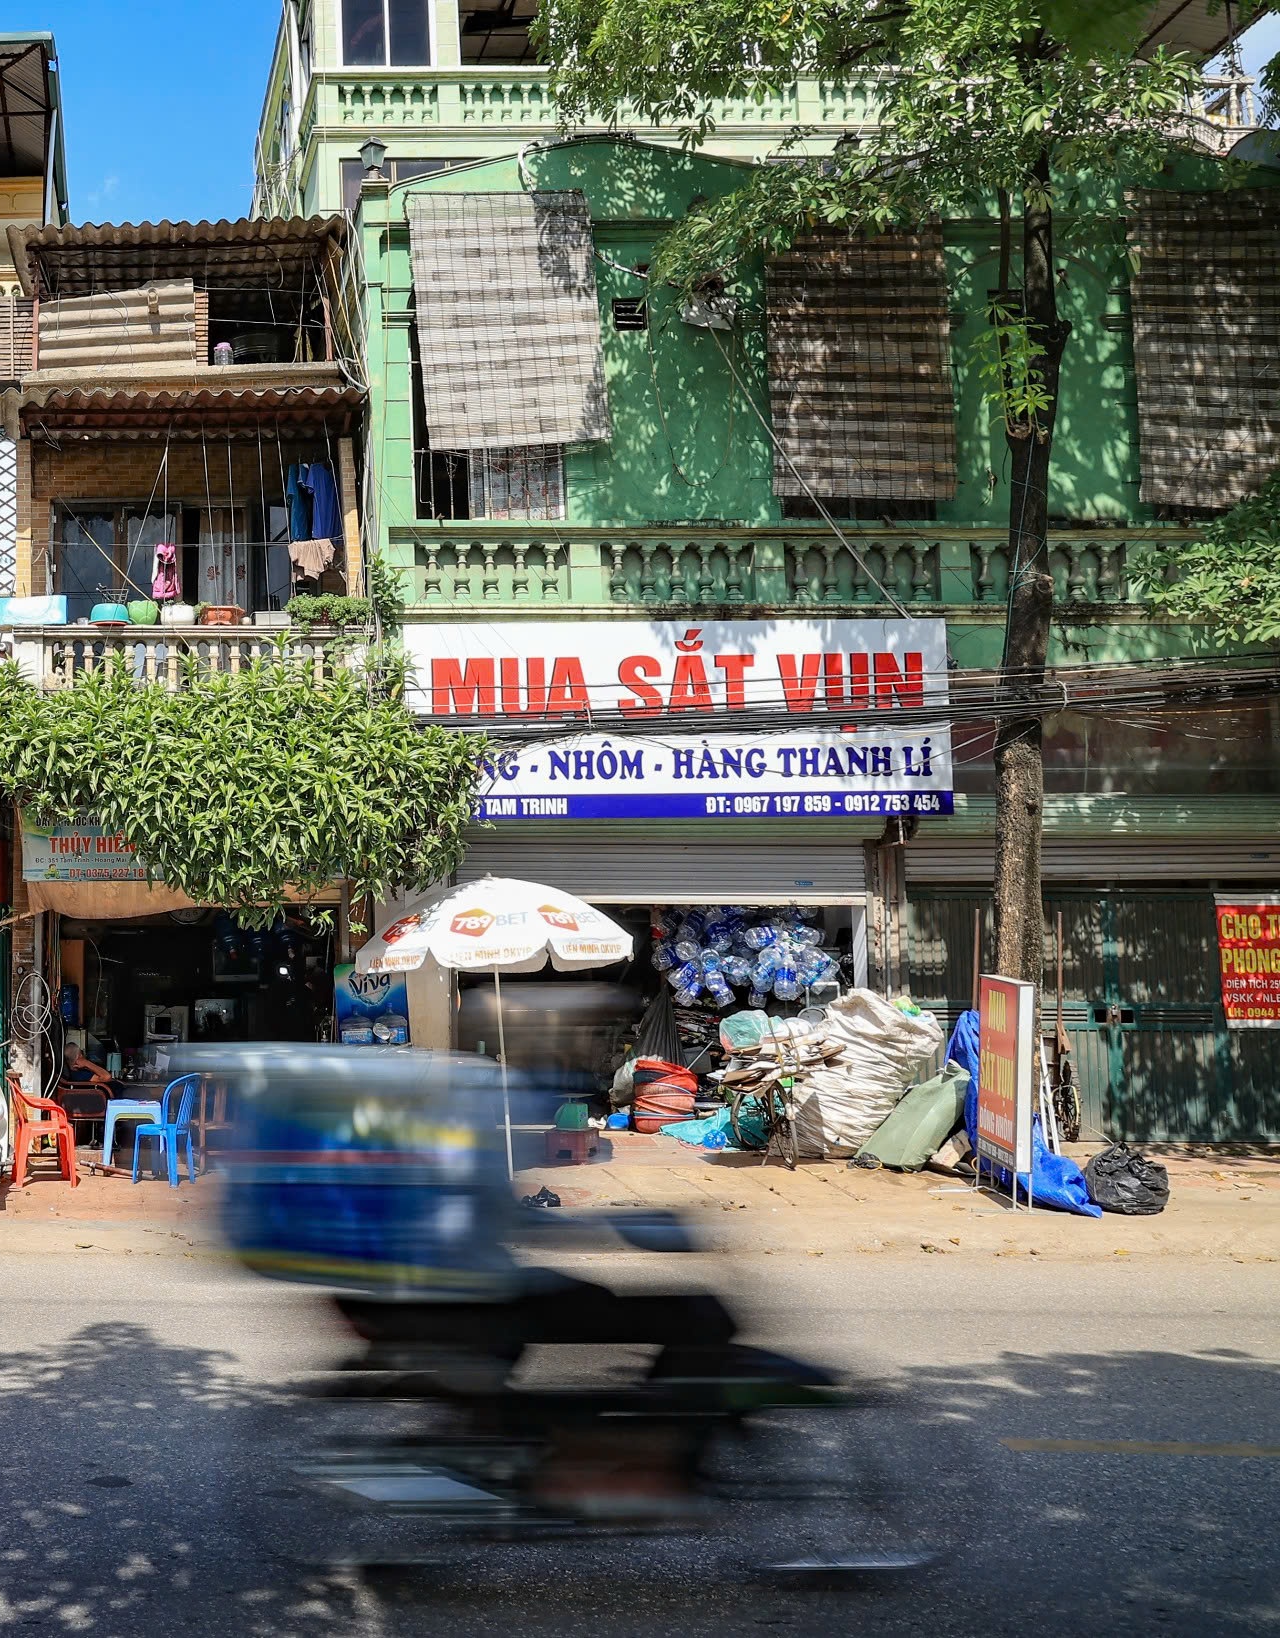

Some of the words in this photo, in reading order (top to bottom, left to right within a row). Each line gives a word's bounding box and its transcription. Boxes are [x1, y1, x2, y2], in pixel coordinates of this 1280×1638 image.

[431, 656, 592, 720] MUA
[617, 627, 755, 719] SẮT
[548, 740, 644, 780] NHÔM
[672, 739, 767, 780] HÀNG
[777, 746, 893, 778] THANH
[902, 737, 934, 778] LÍ
[485, 798, 517, 815] TAM
[521, 797, 568, 815] TRINH
[705, 796, 731, 814] ĐT:
[734, 795, 770, 814] 0967
[773, 795, 801, 813] 197
[803, 794, 832, 813] 859
[844, 794, 880, 812] 0912
[883, 794, 911, 812] 753
[913, 793, 941, 812] 454
[112, 868, 130, 878] 227
[1221, 913, 1261, 940] CHO
[1225, 993, 1254, 1003] VSKK
[988, 989, 1007, 1034] MUA
[1227, 1007, 1245, 1018] LH:
[1247, 1007, 1275, 1018] 0944
